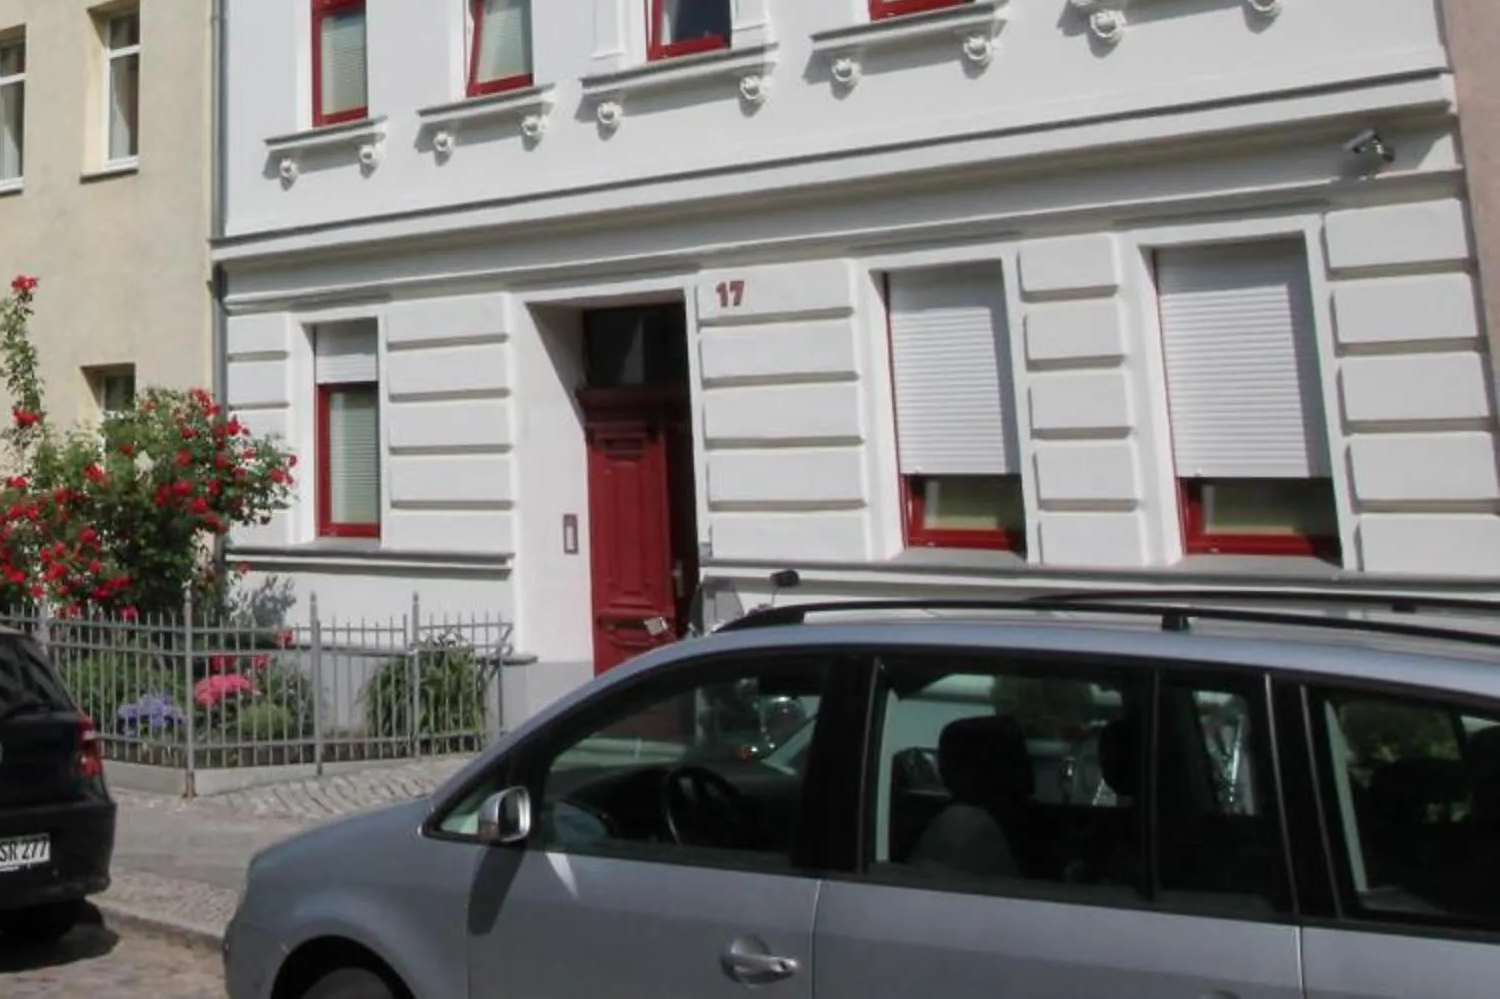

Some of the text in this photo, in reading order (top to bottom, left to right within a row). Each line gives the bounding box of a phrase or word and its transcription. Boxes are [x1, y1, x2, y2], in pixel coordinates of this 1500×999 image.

[716, 280, 745, 308] 17
[0, 840, 18, 862] SR
[22, 837, 48, 860] 277
